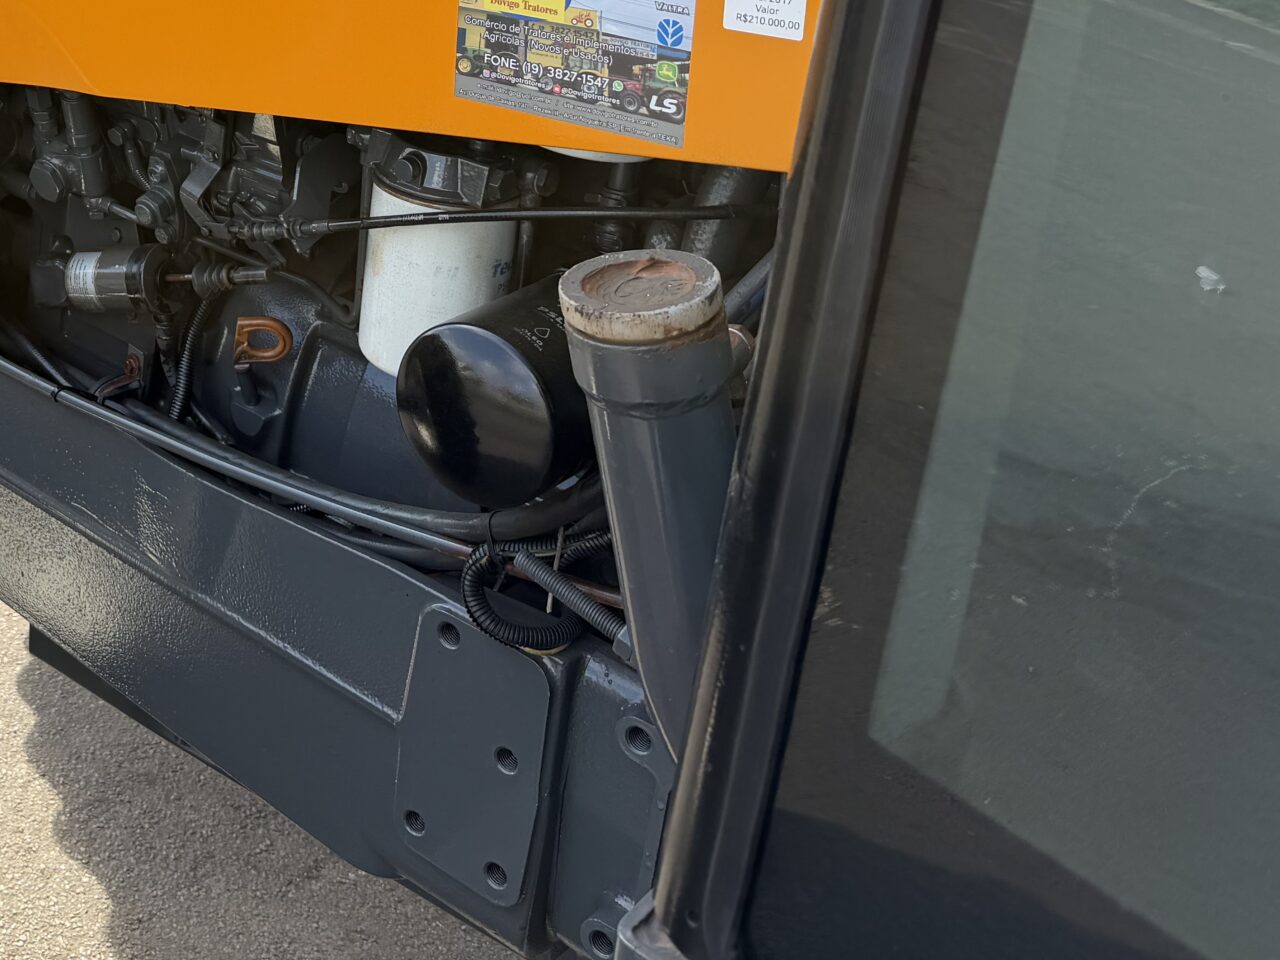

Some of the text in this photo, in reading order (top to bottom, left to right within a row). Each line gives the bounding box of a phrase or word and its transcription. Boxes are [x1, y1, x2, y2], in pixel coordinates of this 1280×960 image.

[522, 0, 558, 16] Tratores
[654, 1, 690, 16] VALTRA
[755, 4, 780, 15] Valor
[736, 12, 800, 30] R$210.000,00
[509, 24, 521, 34] de
[523, 25, 562, 42] Tratores
[564, 35, 571, 43] e
[573, 35, 637, 56] Implementos
[527, 40, 561, 54] (Novos
[563, 48, 571, 56] e
[572, 48, 613, 66] Usados)
[484, 53, 520, 71] FONE:
[522, 61, 543, 78] (19)
[547, 66, 609, 88] 3827-1547
[490, 71, 546, 89] @Dovigotratores
[561, 87, 620, 105] @Dovigotratores
[649, 95, 678, 114] LS
